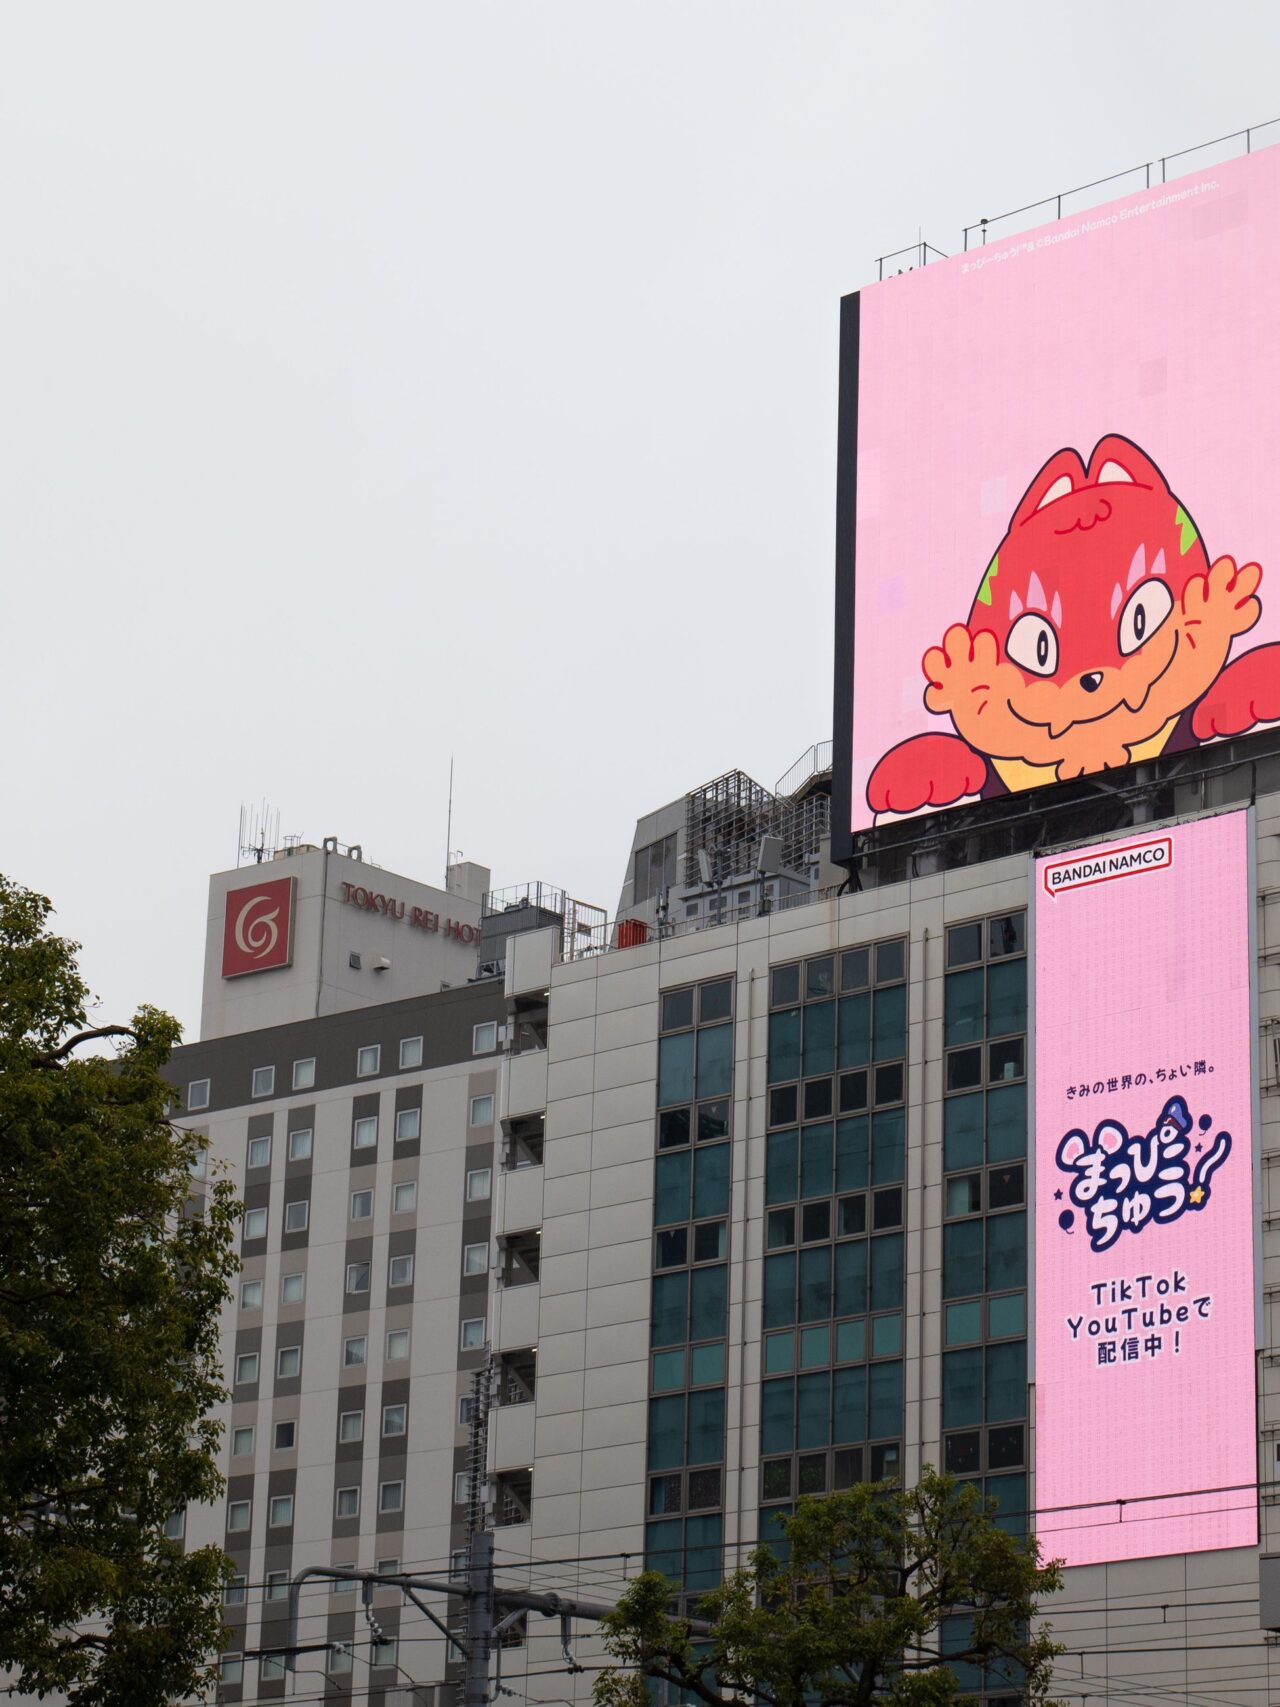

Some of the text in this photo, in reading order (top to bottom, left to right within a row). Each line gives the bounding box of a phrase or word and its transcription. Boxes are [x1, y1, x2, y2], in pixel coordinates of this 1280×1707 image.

[1082, 215, 1118, 234] Namco
[1119, 187, 1199, 220] Entertainment
[1201, 180, 1220, 194] Inc.
[1052, 847, 1165, 885] BANDAI NAMCO
[341, 881, 406, 920] TOKYU
[409, 906, 439, 933] REI
[1066, 1059, 1215, 1100] きみの世界の、ちょい隣。
[1091, 1270, 1186, 1305] TikTok
[1067, 1296, 1211, 1339] YouTubeで
